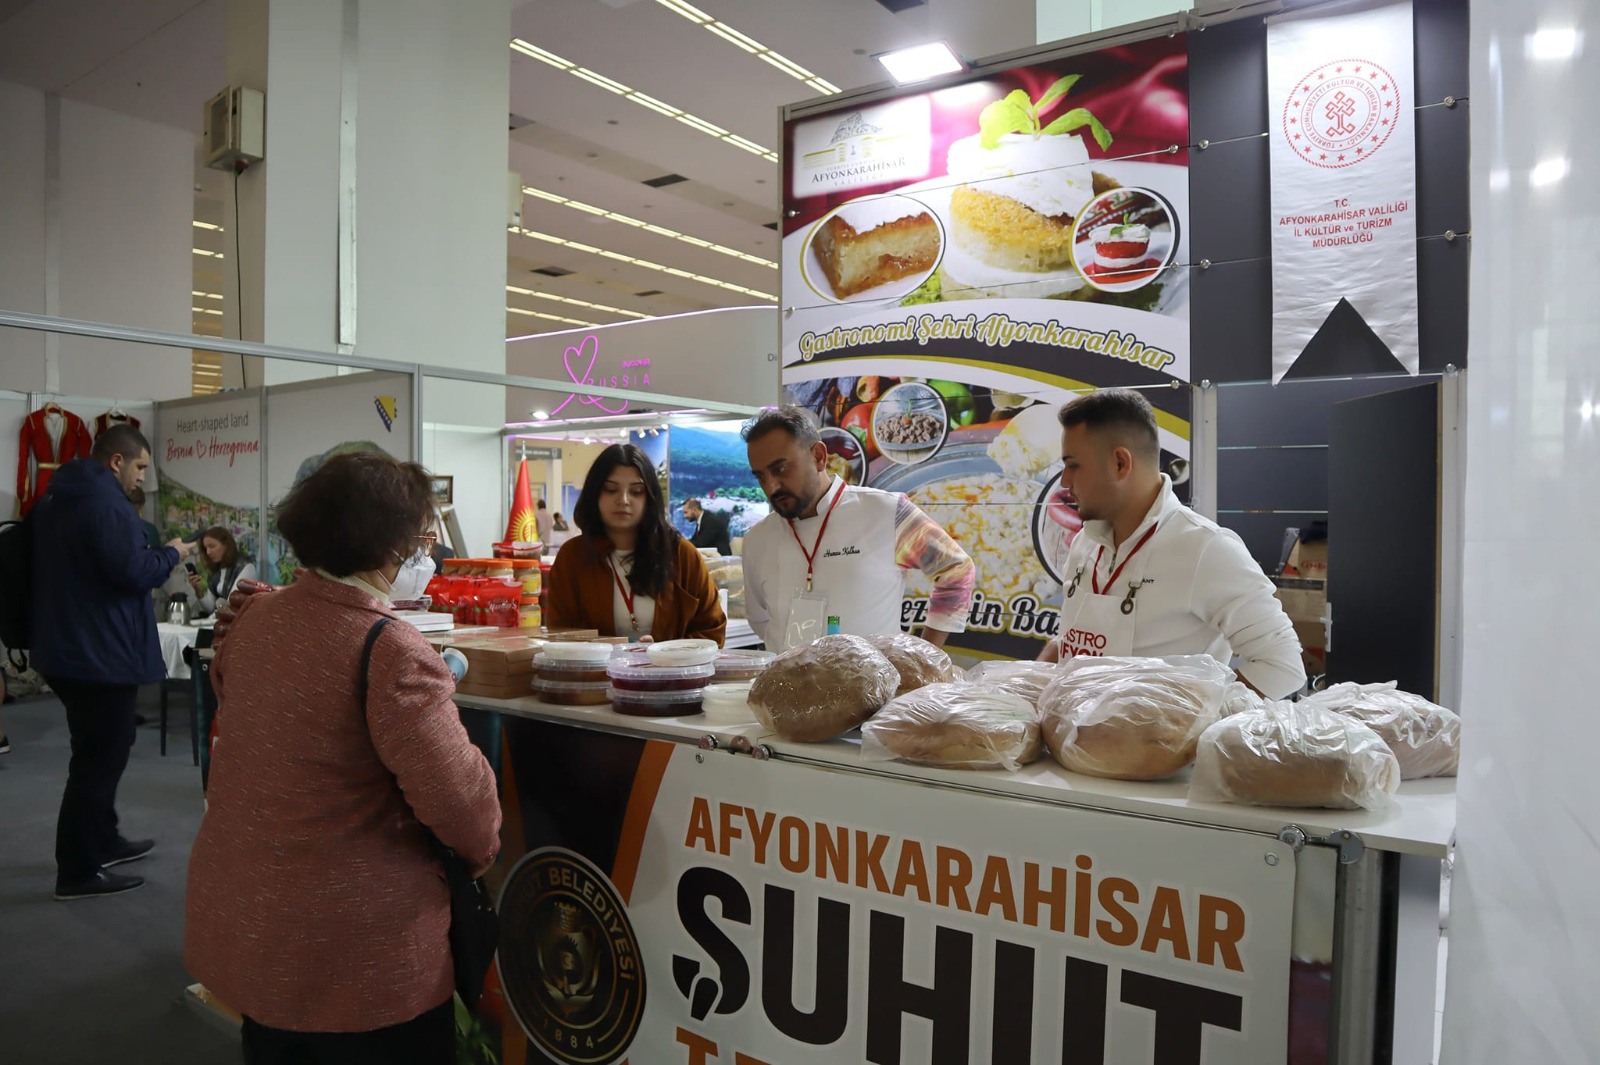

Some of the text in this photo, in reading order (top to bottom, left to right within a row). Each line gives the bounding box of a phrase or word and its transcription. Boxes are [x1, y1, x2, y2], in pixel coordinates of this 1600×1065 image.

[1279, 200, 1408, 226] AFYONKARAHİSAR VALİLİĞİ
[1304, 224, 1341, 236] KÜLTÜR
[1356, 217, 1392, 231] TURİZM
[1312, 231, 1373, 248] MÜDÜRLÜĞÜ
[800, 314, 1174, 371] Gastronomi Şehri Afyonkarahisar
[177, 411, 249, 434] Heart-shaped land
[167, 434, 259, 468] Bosnia Herzegovina
[684, 796, 1246, 973] AFYONKARAHİSAR
[550, 868, 635, 980] BELEDİYESİ
[543, 1018, 594, 1049] 1884
